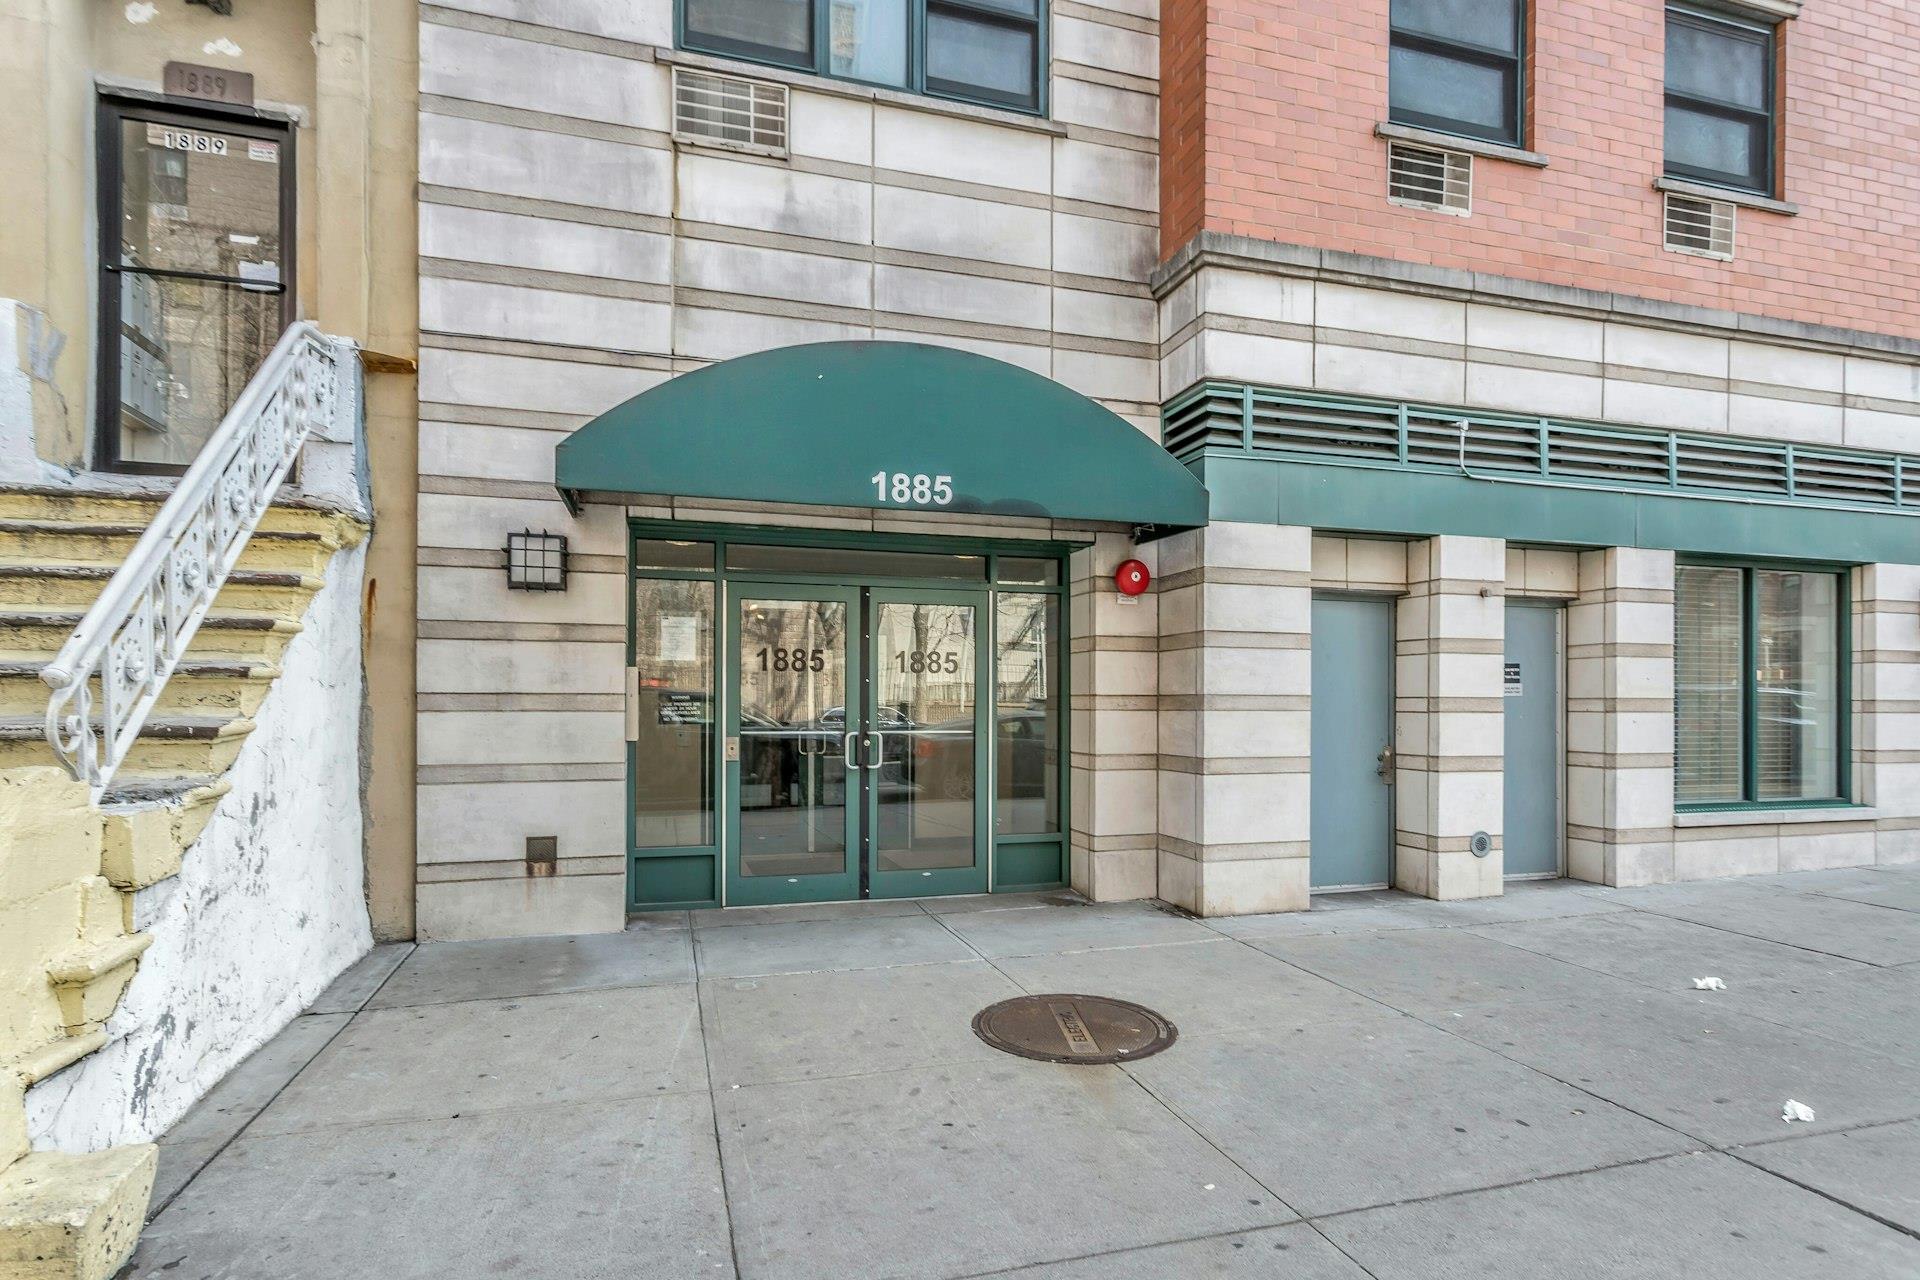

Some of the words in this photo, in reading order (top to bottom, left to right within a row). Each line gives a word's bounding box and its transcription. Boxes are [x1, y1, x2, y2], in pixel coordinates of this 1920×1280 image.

[179, 69, 226, 97] 1889
[166, 133, 225, 153] 1889
[871, 471, 953, 505] 1885
[756, 648, 825, 673] 1885
[895, 650, 959, 674] 1885
